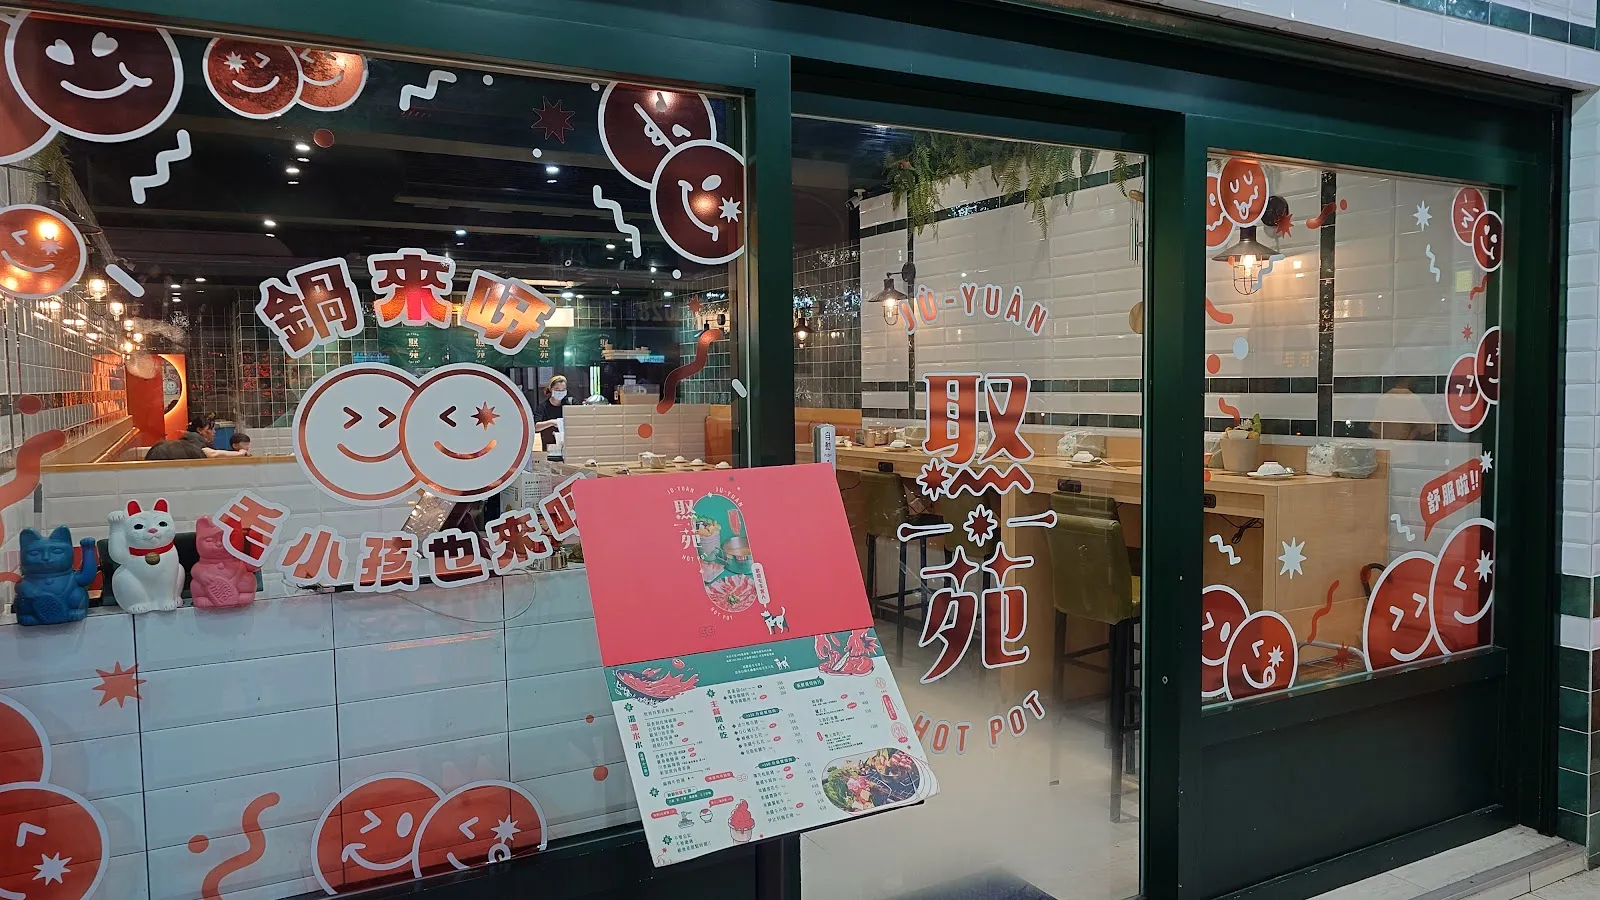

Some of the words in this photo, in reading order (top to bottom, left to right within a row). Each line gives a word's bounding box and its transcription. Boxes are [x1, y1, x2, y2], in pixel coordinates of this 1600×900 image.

[258, 250, 554, 355] 鍋來呀
[913, 713, 971, 752] HOT
[988, 692, 1044, 746] POT
